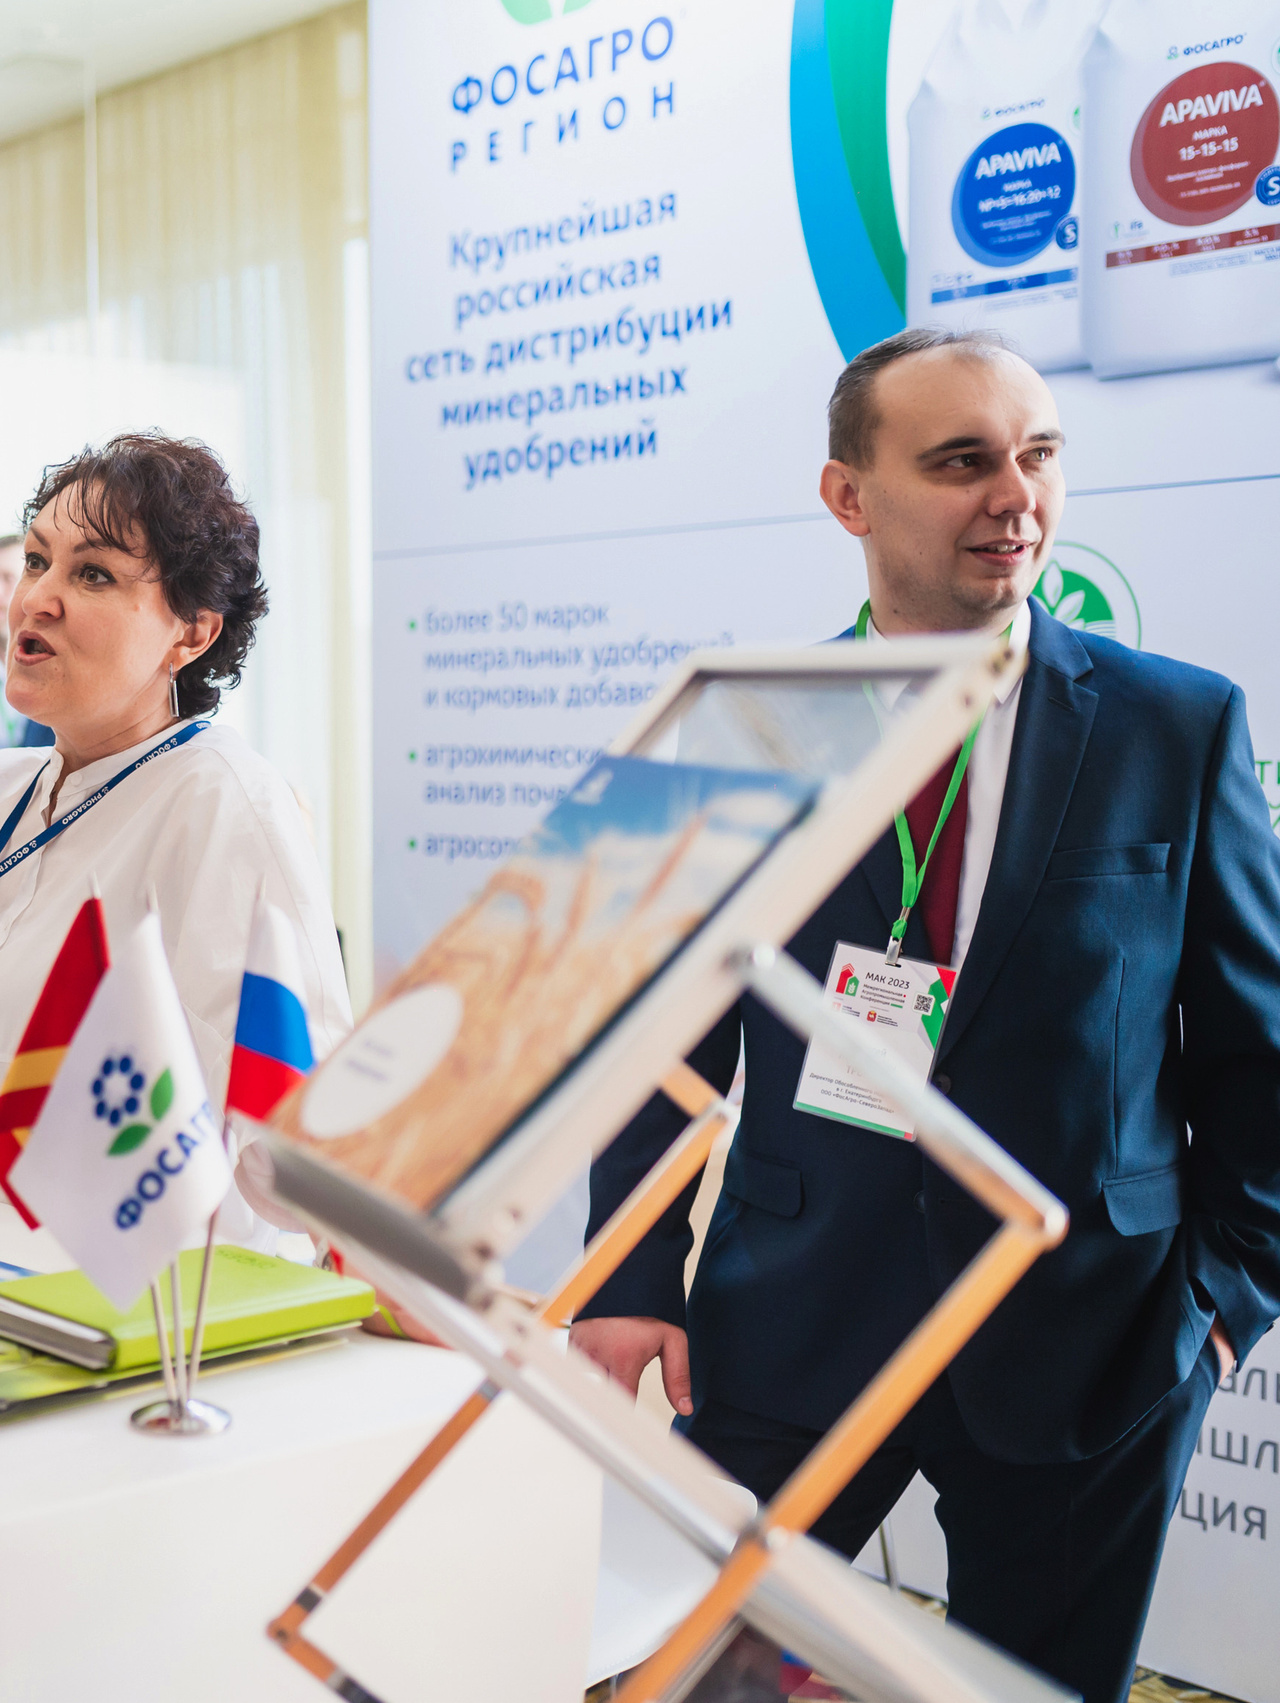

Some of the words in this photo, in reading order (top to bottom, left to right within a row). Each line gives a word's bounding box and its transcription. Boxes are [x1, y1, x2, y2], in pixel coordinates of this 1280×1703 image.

[1184, 34, 1244, 57] ФОСАГРО
[452, 16, 674, 115] ФОСАГРО
[1159, 83, 1263, 128] APAVIVA
[450, 81, 675, 173] РЕГИОН
[974, 142, 1061, 180] APAVIVA
[1179, 137, 1239, 160] 15-15-15
[450, 193, 676, 271] Крупнейшая
[454, 254, 661, 329] российская
[405, 348, 475, 384] сеть
[483, 299, 733, 375] дистрибуции
[441, 367, 687, 427] минеральных
[464, 418, 658, 491] удобрений
[425, 608, 493, 634] более
[500, 601, 528, 631] 50
[535, 603, 610, 635] марок
[425, 643, 584, 674] минеральных
[426, 690, 439, 707] и
[445, 687, 560, 715] кормовых
[62, 792, 103, 825] PHOSAGRO
[426, 780, 506, 805] анализ
[865, 971, 887, 984] МАК
[887, 977, 910, 990] 2023
